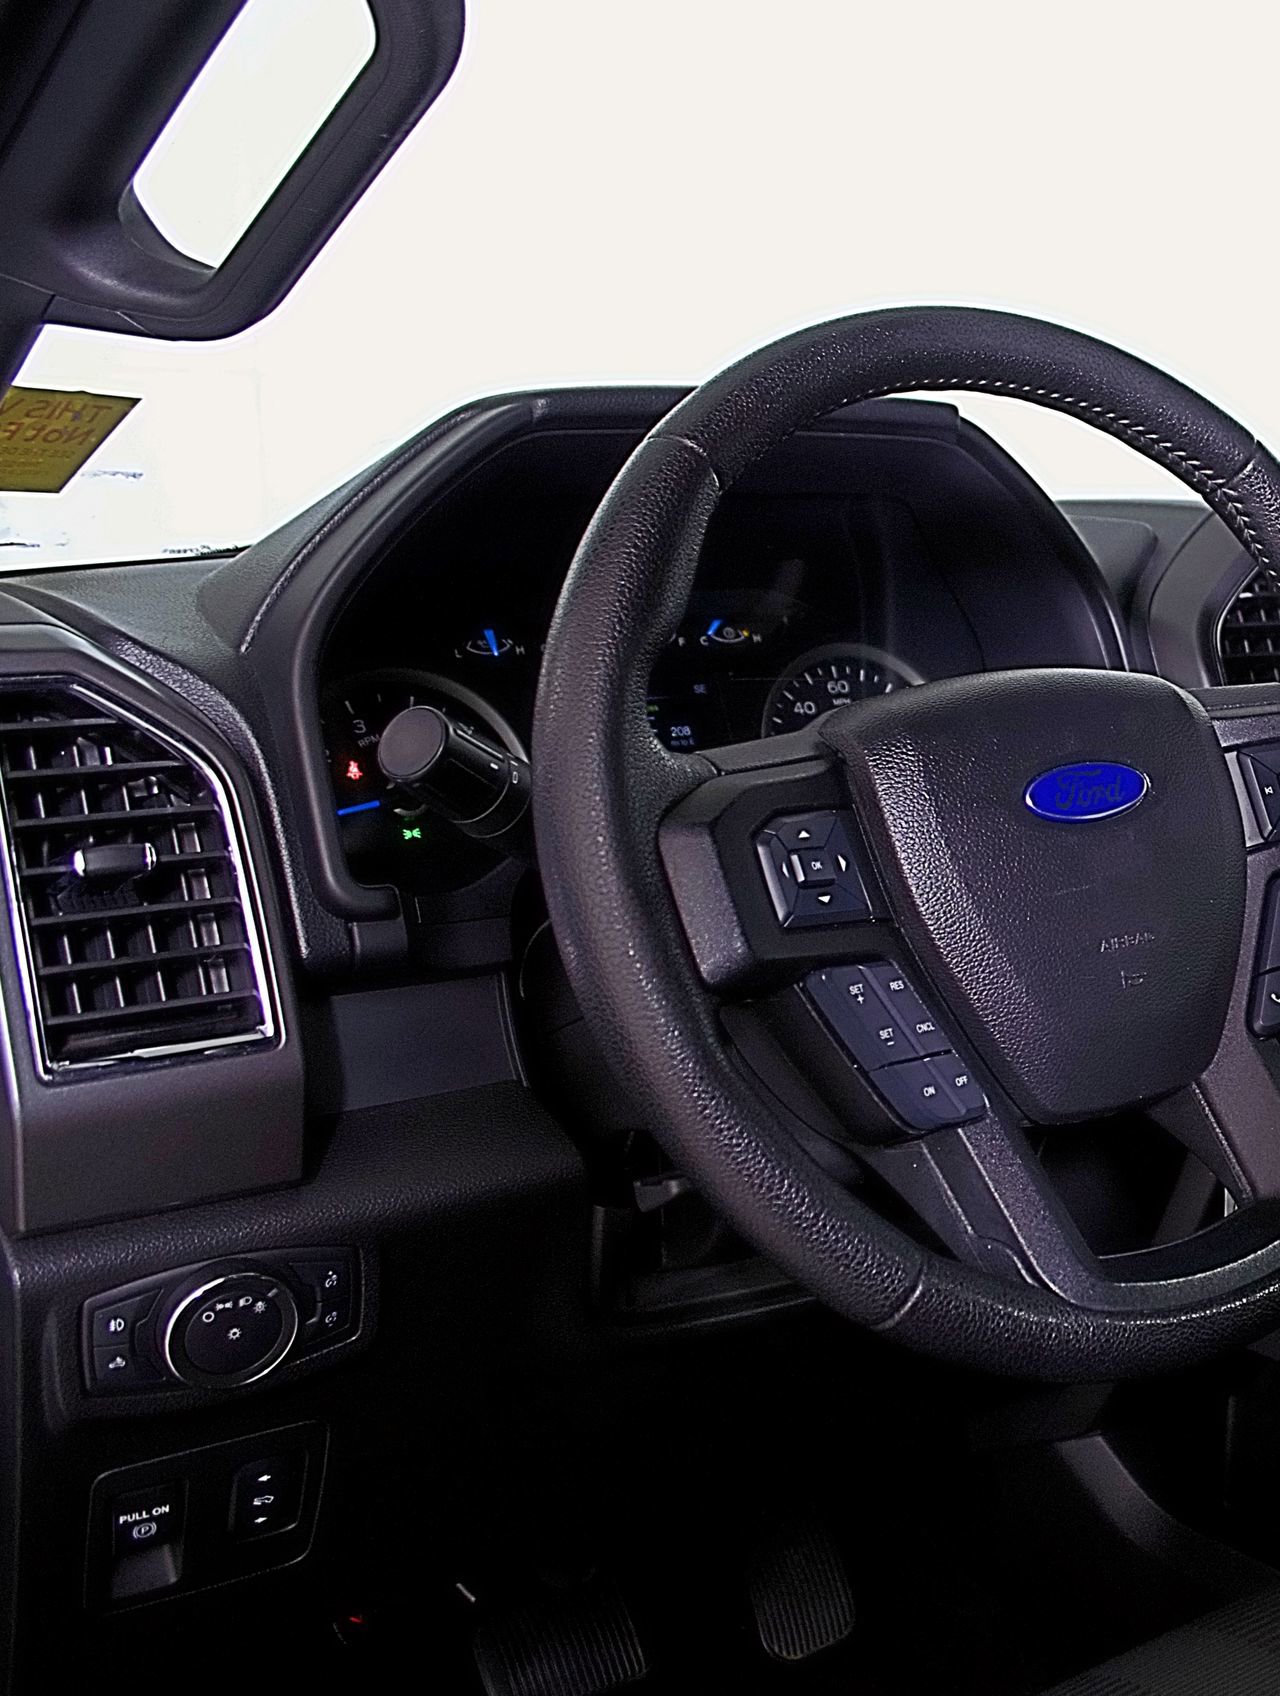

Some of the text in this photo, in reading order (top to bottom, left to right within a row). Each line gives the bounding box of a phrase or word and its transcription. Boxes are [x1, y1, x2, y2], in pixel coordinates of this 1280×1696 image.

[827, 680, 850, 695] 60
[793, 702, 816, 716] 40
[352, 719, 368, 734] 3
[1056, 768, 1125, 810] Ford
[849, 982, 864, 995] SET
[889, 979, 904, 992] RES
[879, 1027, 894, 1040] SET
[915, 1021, 935, 1034] CNCL
[955, 1074, 968, 1087] OFF
[923, 1085, 935, 1098] ON
[120, 1503, 170, 1524] PULL ON
